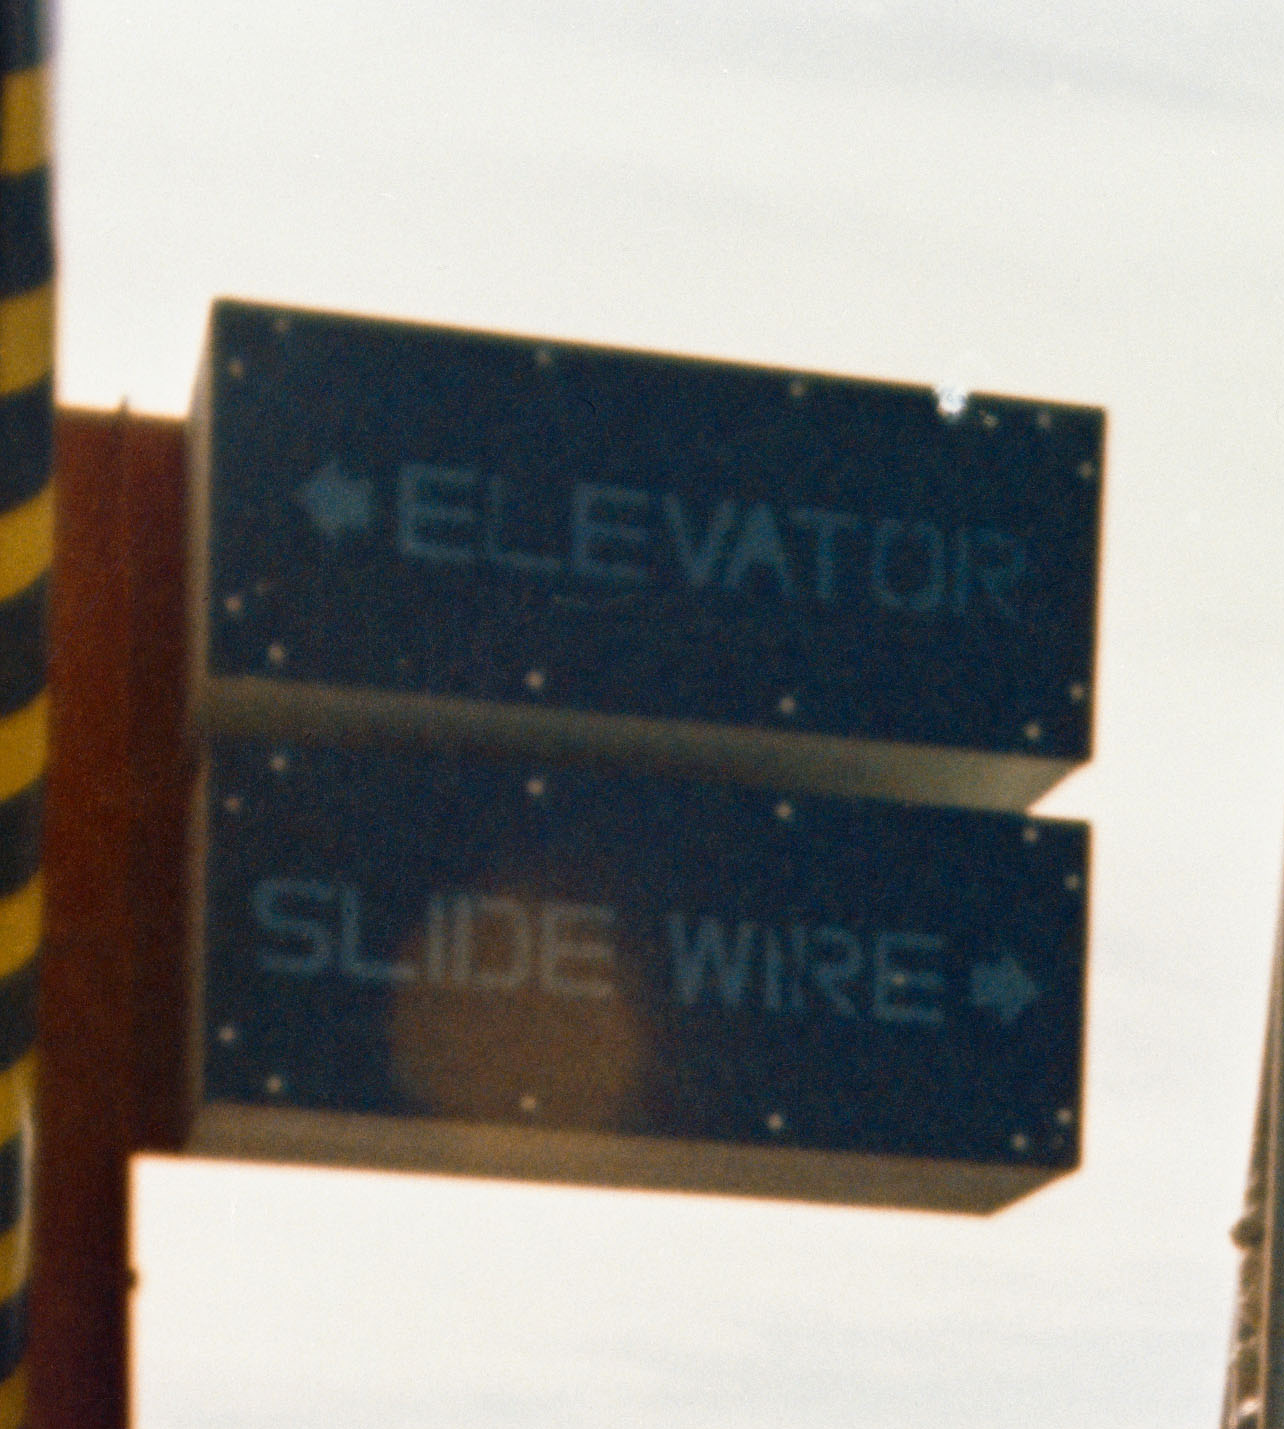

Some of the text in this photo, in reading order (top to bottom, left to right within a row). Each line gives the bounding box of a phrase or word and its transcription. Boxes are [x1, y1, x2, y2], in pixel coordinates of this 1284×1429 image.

[400, 463, 1034, 616] ELEVATOR
[250, 878, 949, 1027] SLIDE WIRE
